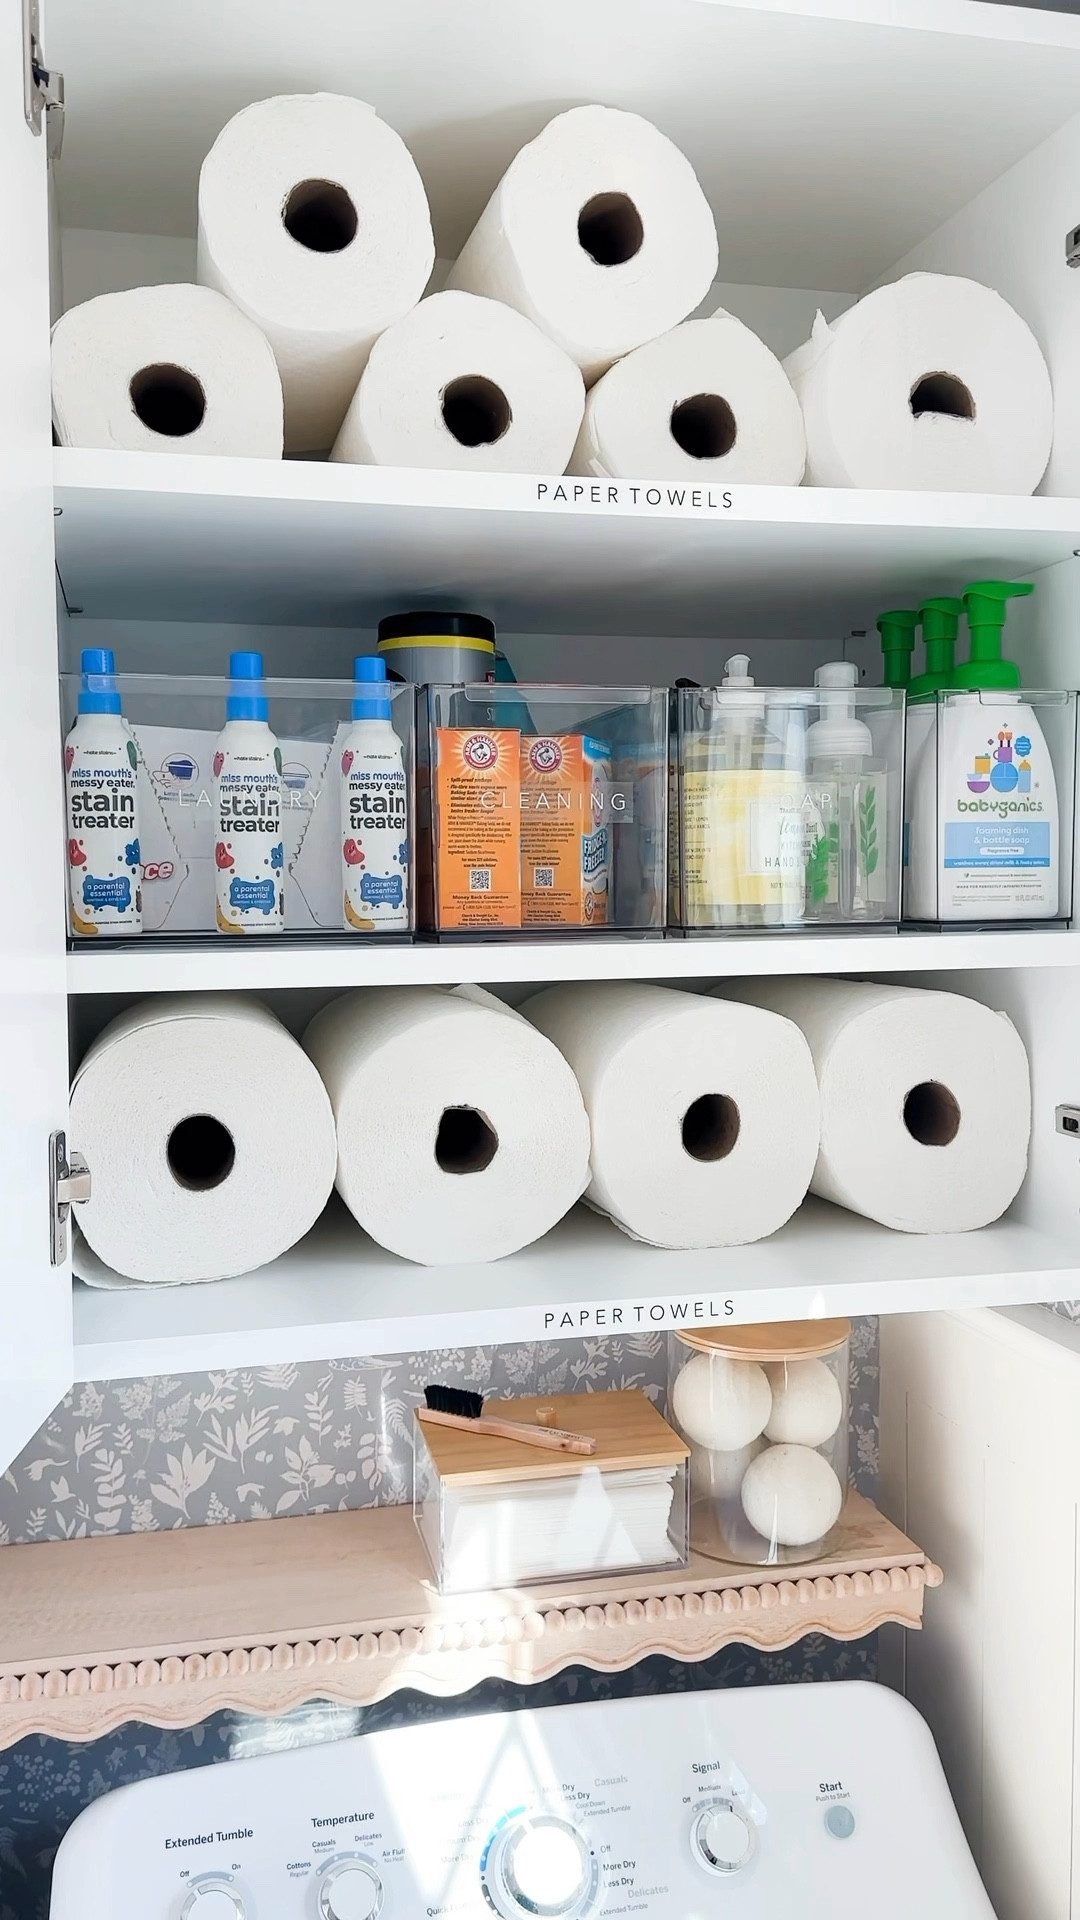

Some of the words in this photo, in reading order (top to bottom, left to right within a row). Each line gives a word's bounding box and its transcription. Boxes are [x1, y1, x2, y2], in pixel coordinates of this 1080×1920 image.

[537, 484, 618, 503] PAPER
[629, 488, 732, 508] TOWELS
[72, 768, 91, 778] miss
[94, 768, 132, 778] mouth's
[221, 774, 241, 783] miss
[243, 774, 278, 783] mouth's
[351, 772, 371, 781] miss
[373, 772, 404, 781] mouth's
[71, 780, 104, 789] messy
[220, 784, 253, 794] messy
[349, 782, 383, 791] messy
[71, 788, 134, 812] stain
[179, 790, 322, 808] LAUNDRY
[220, 793, 279, 816] stain
[349, 790, 405, 813] stain
[482, 791, 625, 810] CLEANING
[957, 797, 1043, 819] babyganics
[72, 814, 135, 829] treater
[220, 818, 280, 833] treater
[349, 815, 405, 829] treater
[976, 827, 1011, 837] foaming
[1011, 837, 1030, 845] soap
[93, 882, 125, 891] parental
[545, 1308, 623, 1328] PAPER
[633, 1300, 734, 1322] TOWELS
[692, 1761, 721, 1774] Signal
[594, 1775, 629, 1787] Casuals
[562, 1783, 575, 1792] Dry
[698, 1784, 722, 1792] Medium
[819, 1781, 843, 1793] Start
[577, 1792, 590, 1800] Dry
[816, 1794, 830, 1802] Push
[836, 1791, 851, 1799] Start
[584, 1808, 610, 1817] Extended
[611, 1804, 631, 1812] Tumble
[311, 1811, 375, 1828] Temperature
[165, 1833, 214, 1849] Extended
[216, 1828, 254, 1843] Tumble
[354, 1832, 383, 1842] Delicates
[312, 1839, 336, 1848] Casuals
[600, 1845, 611, 1853] Off
[287, 1862, 311, 1870] Cottons
[603, 1863, 622, 1871] More
[623, 1860, 636, 1869] Dry
[180, 1870, 190, 1878] Off
[621, 1877, 634, 1886] Dry
[628, 1886, 669, 1898] Delicates
[600, 1907, 626, 1916] Extended
[627, 1903, 648, 1911] Tumble
